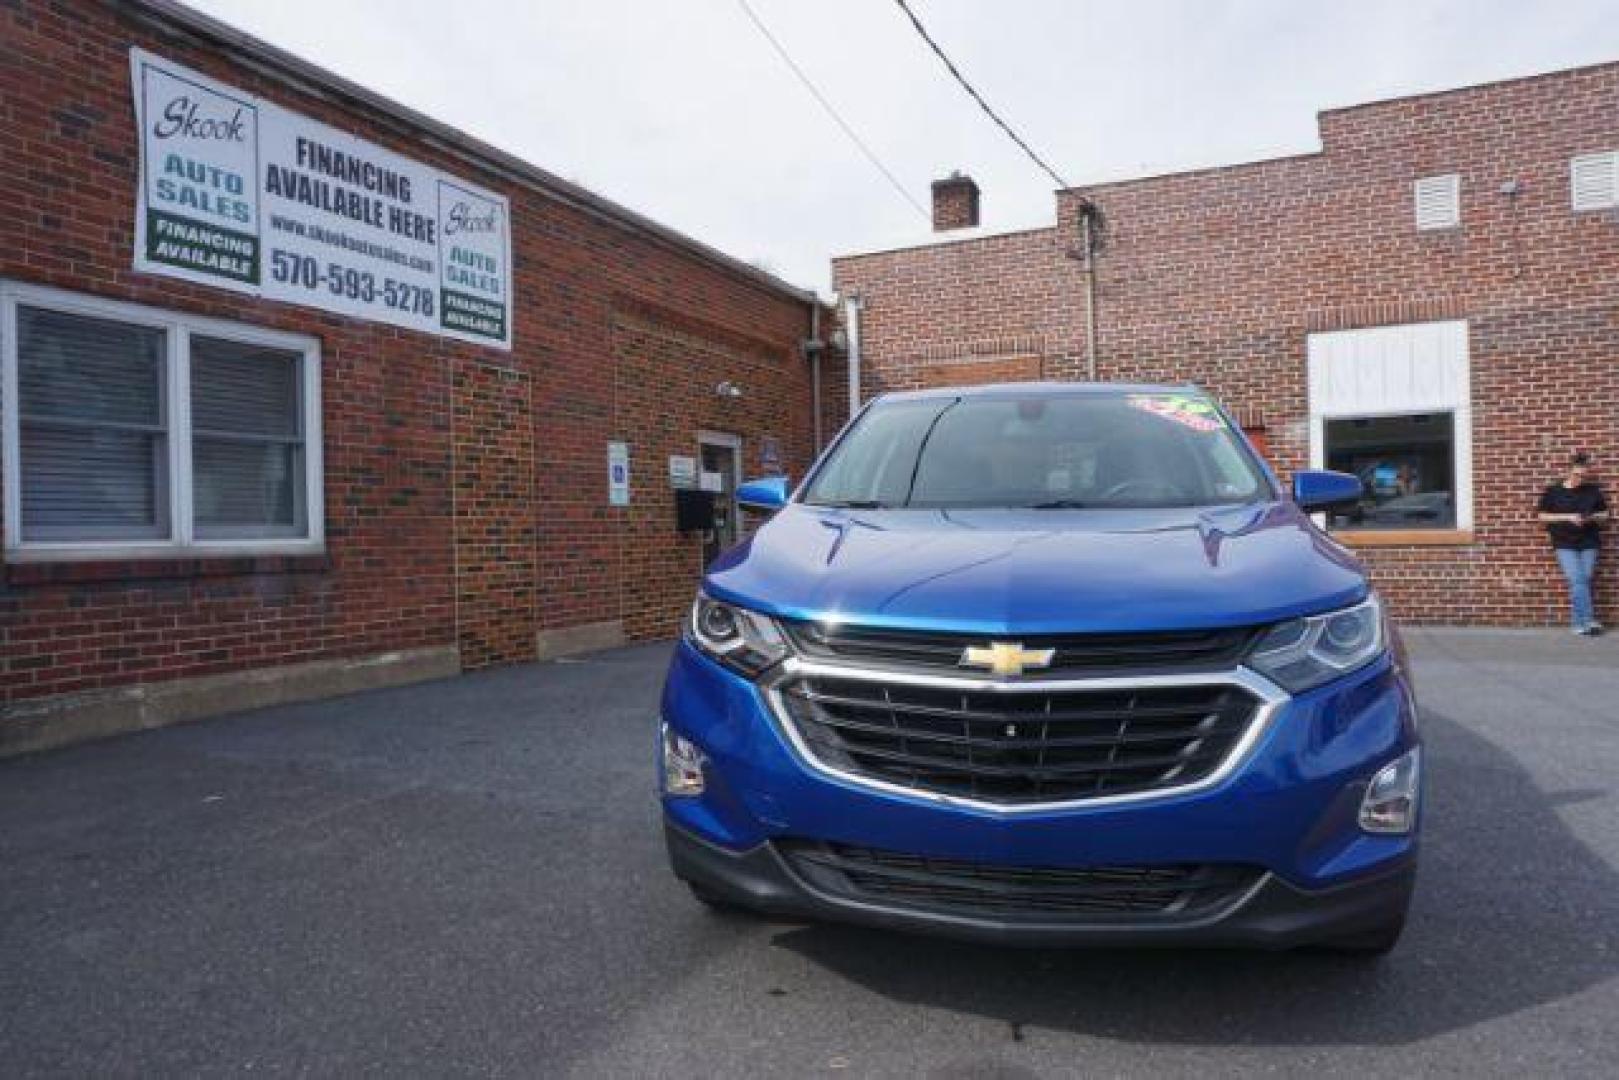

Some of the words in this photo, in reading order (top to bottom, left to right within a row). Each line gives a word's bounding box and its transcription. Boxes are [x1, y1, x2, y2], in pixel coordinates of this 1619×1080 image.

[154, 96, 244, 142] Skook
[164, 153, 243, 196] AUTO
[296, 136, 411, 203] FINANCING
[156, 179, 249, 224] SALES
[266, 163, 384, 229] AVAILABLE
[389, 205, 436, 246] HERE
[156, 219, 254, 257] FINANCING
[156, 241, 251, 276] AVAILABLE
[449, 246, 497, 274] AUTO
[271, 249, 434, 317] 570-593-5278
[446, 265, 499, 294] SALES
